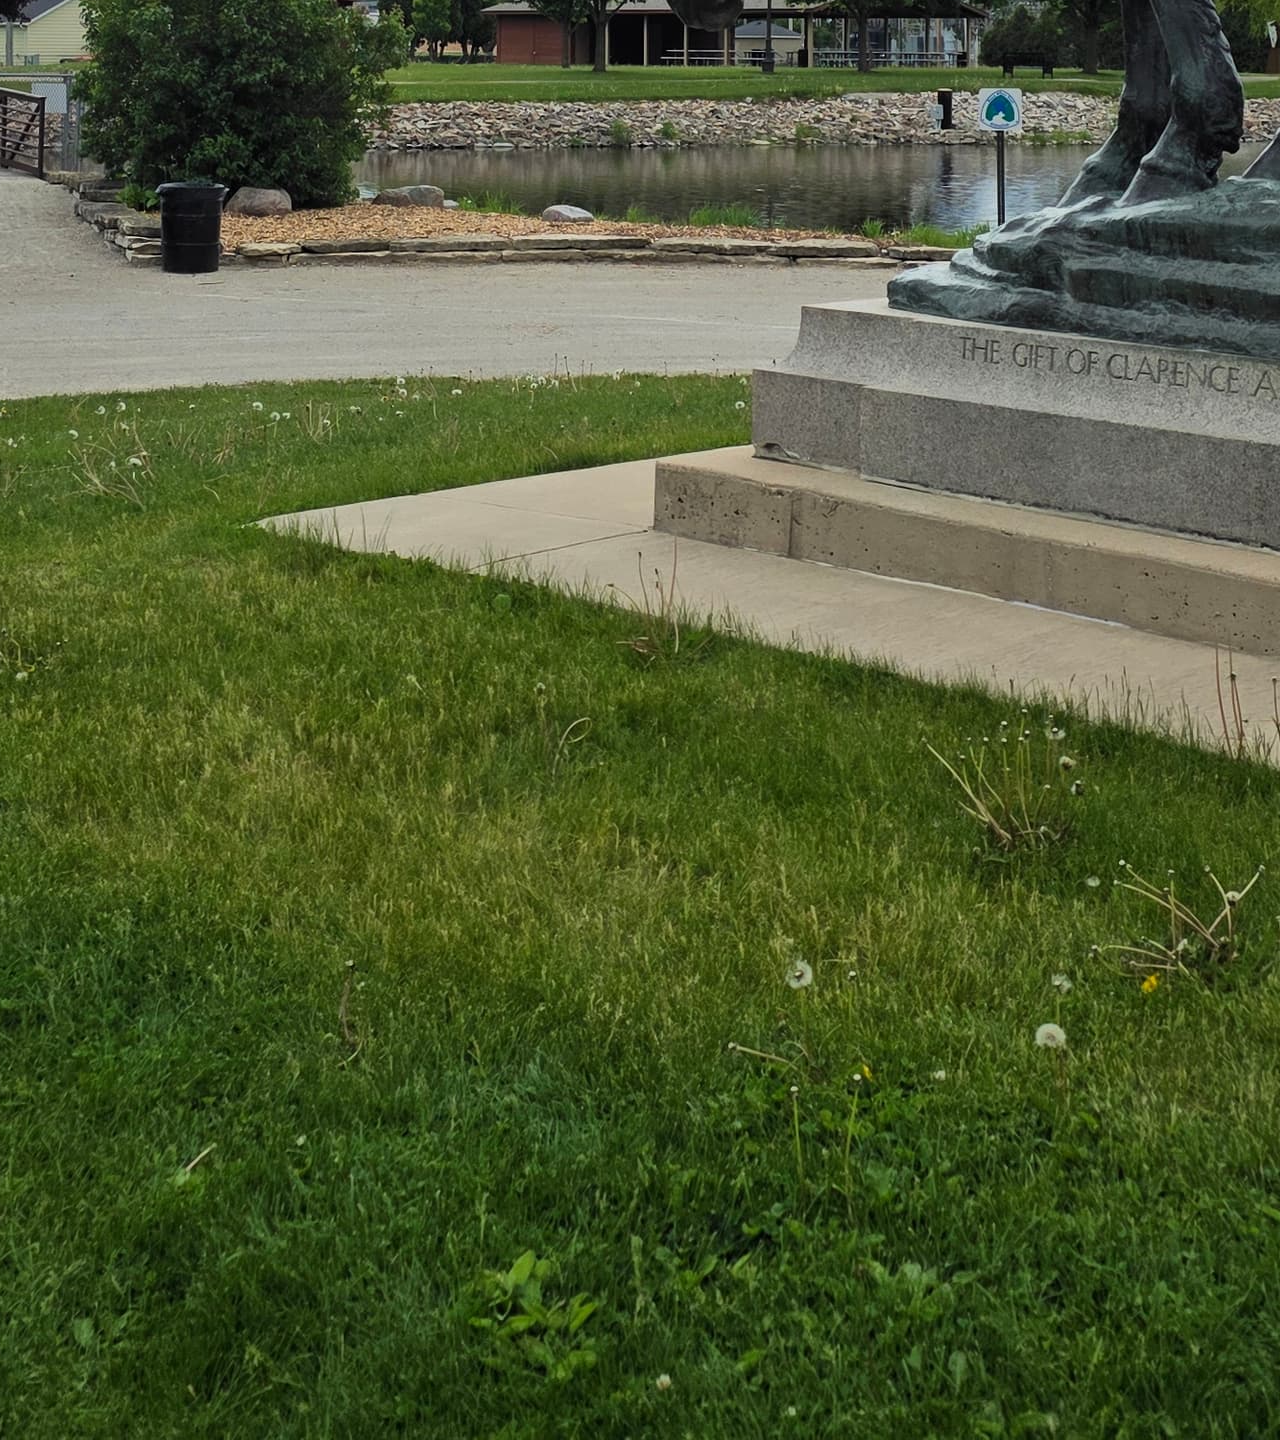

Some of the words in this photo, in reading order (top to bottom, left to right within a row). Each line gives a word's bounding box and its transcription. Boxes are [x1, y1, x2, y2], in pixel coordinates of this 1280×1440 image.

[959, 336, 1001, 364] THE
[1012, 342, 1059, 371] GIFT
[1066, 348, 1099, 375] OF
